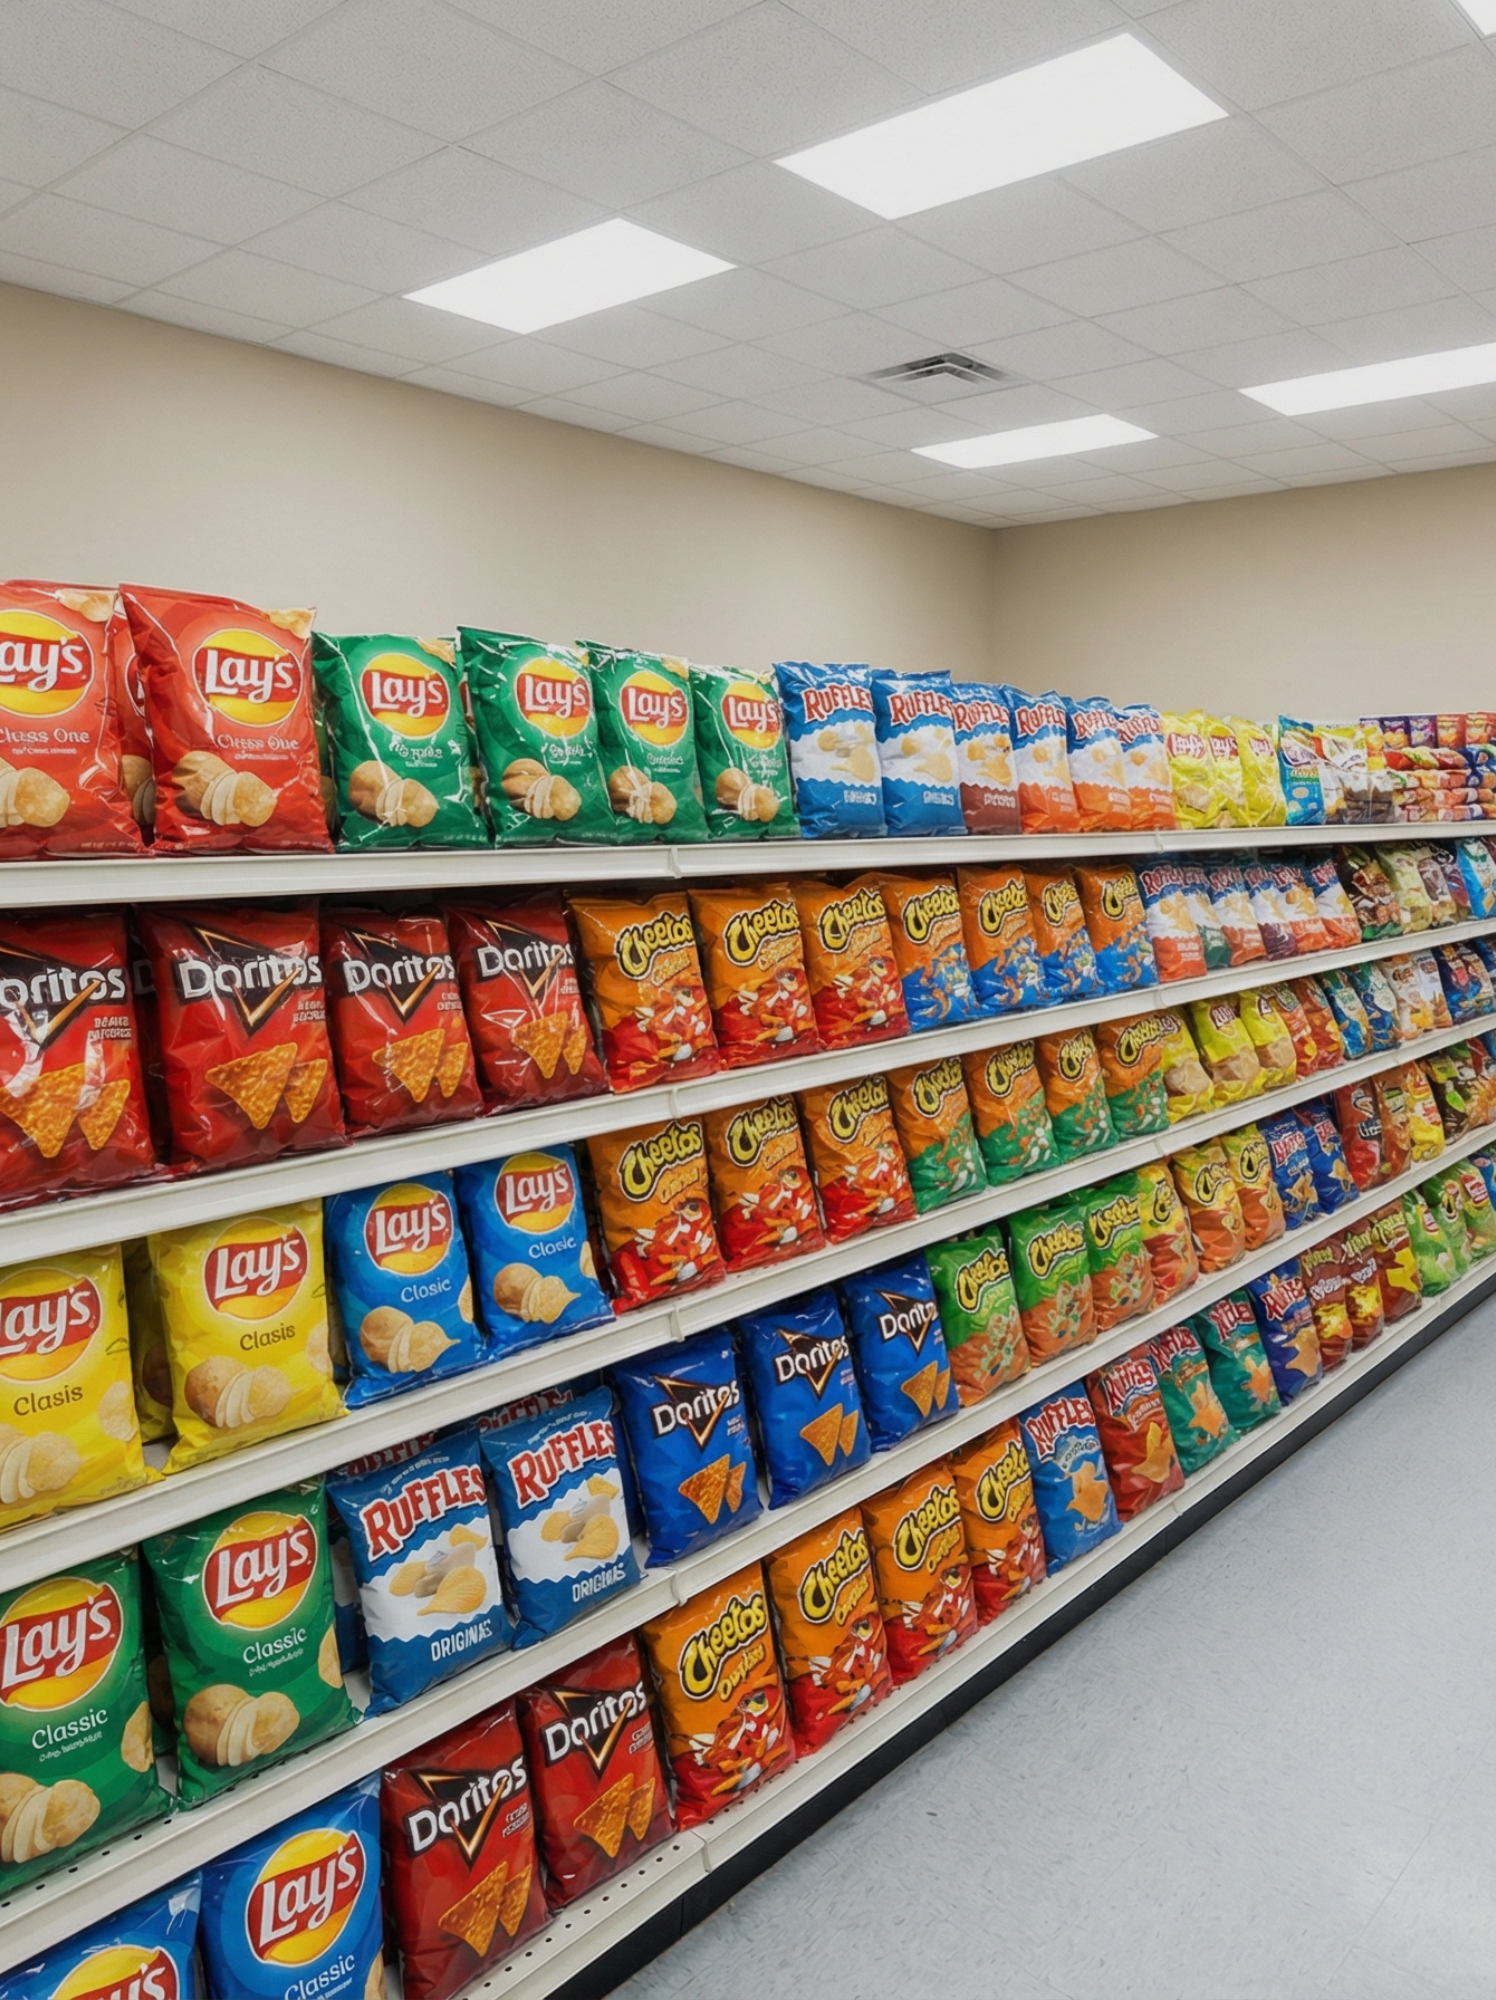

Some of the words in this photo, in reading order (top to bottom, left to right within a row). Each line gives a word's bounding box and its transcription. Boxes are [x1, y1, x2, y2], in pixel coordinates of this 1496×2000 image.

[205, 649, 294, 704] Lay's
[371, 671, 443, 718] Lay's
[0, 966, 126, 1009] oritos
[178, 954, 322, 1000] Doritos
[343, 953, 454, 993] Doritos
[505, 1164, 570, 1216] Lay's
[621, 1123, 701, 1201] Cheetos
[375, 1198, 447, 1256] Lay's
[215, 1234, 300, 1300] Lay's
[507, 1420, 617, 1510] RUFFLES
[360, 1464, 487, 1563] RUFFLES
[216, 1526, 309, 1609] Lay's
[802, 1530, 870, 1622] Cheetos
[1, 1595, 112, 1690] Lay's
[242, 1627, 308, 1665] Classic
[682, 1594, 767, 1698] Cheetos
[32, 1708, 109, 1750] Classic
[545, 1681, 646, 1762] Doritos
[408, 1755, 527, 1853] Doritos
[258, 1845, 357, 1948] Lay's
